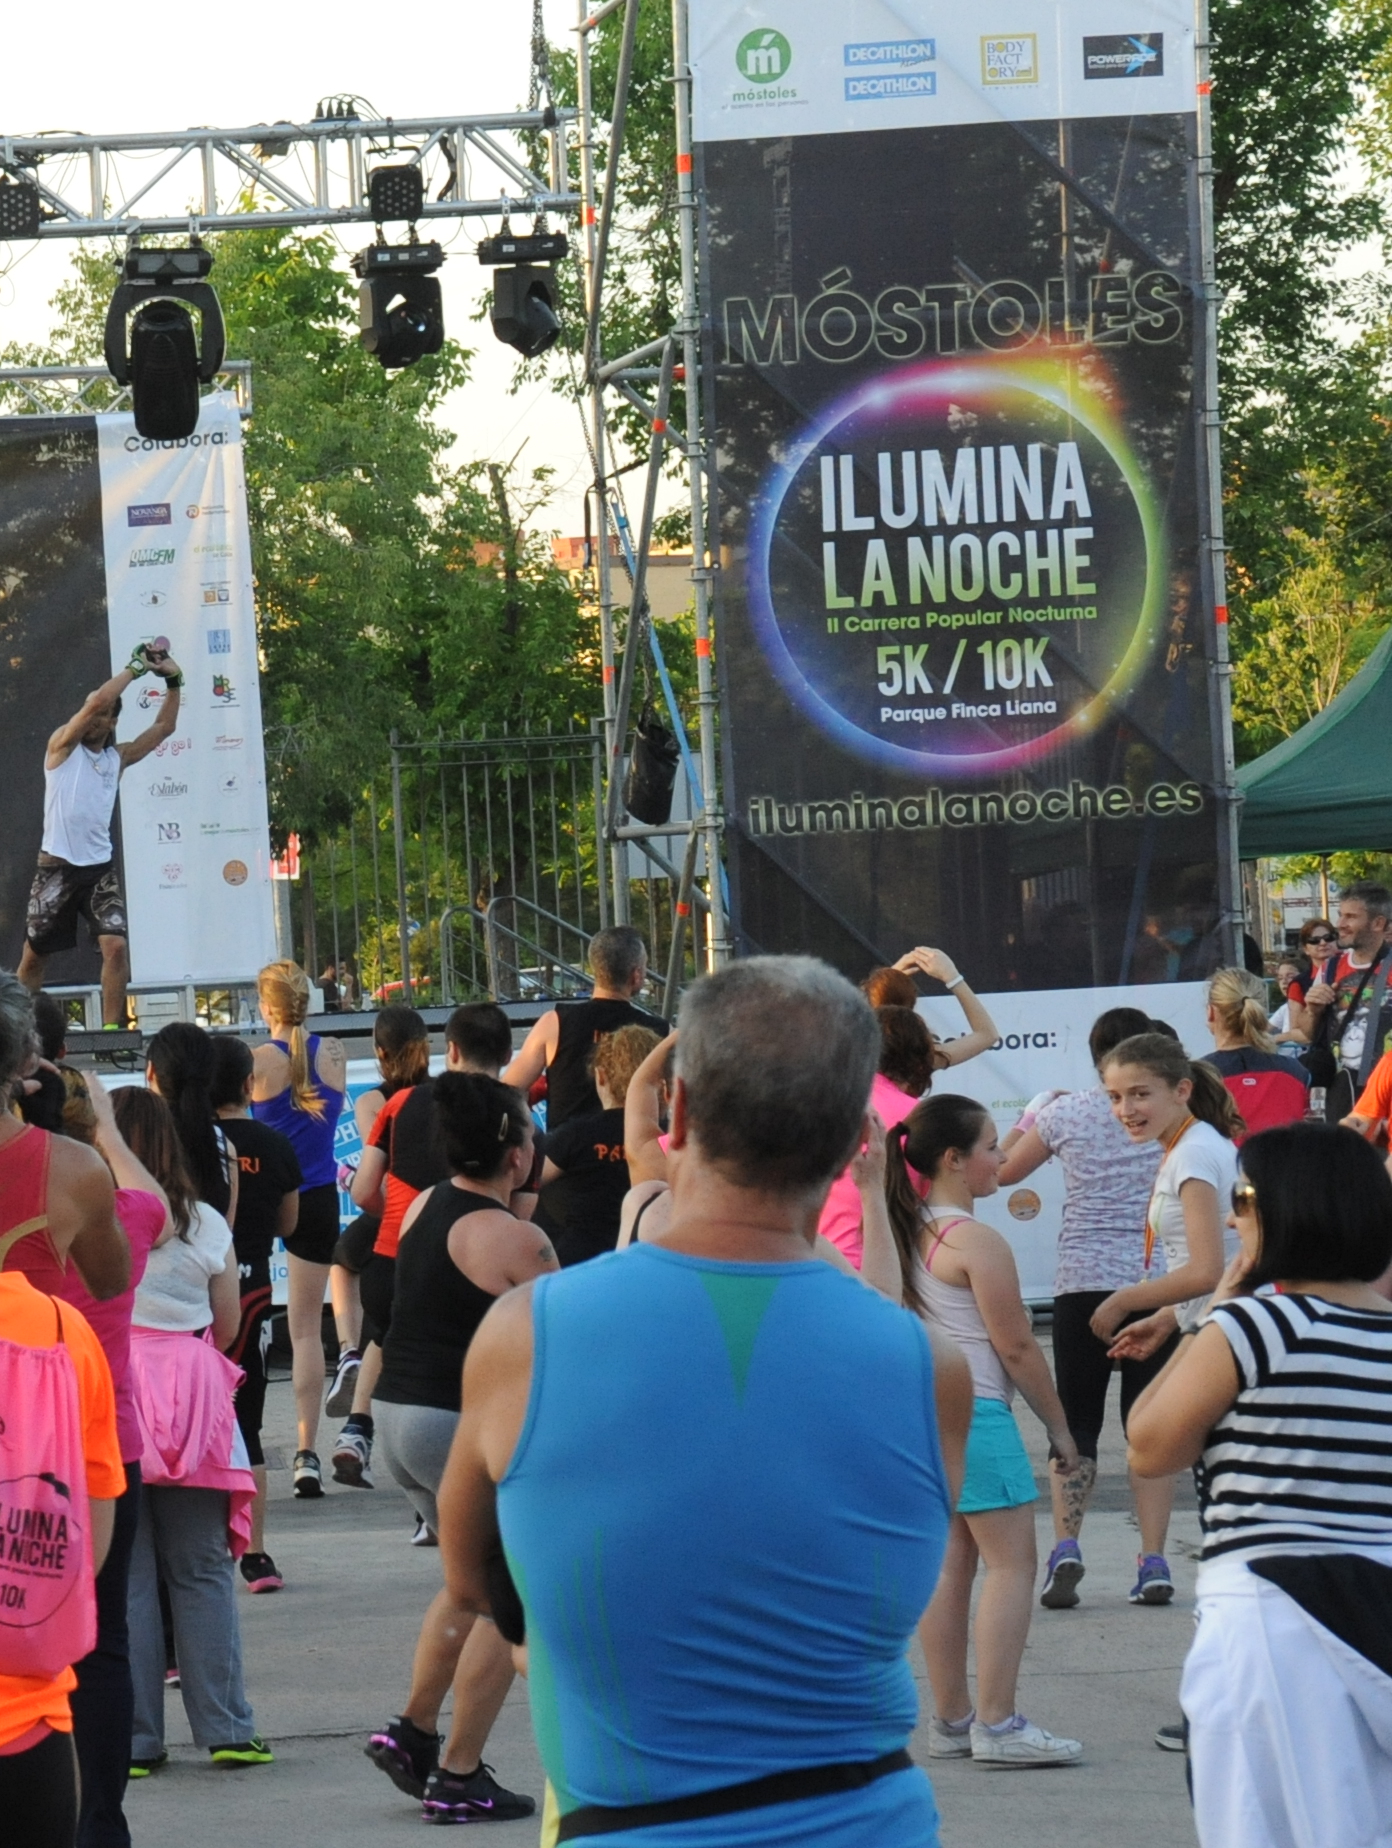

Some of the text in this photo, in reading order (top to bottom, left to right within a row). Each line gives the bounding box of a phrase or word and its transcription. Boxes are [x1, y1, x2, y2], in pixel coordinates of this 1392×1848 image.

[849, 43, 931, 61] DECATHLON
[987, 41, 1026, 54] BODY
[987, 53, 1023, 66] FACT
[733, 86, 797, 102] móstoles
[849, 76, 931, 95] DECATHLON
[723, 266, 1183, 367] MÓSTOLES
[820, 442, 1092, 532] ILUMINA
[823, 527, 1097, 609] LA NOCHE
[844, 614, 920, 631] Carrera
[926, 609, 1002, 630] Popular
[1008, 604, 1097, 623] Nocturna
[877, 644, 933, 696] 5K
[977, 636, 1053, 690] 10K
[881, 699, 1056, 723] Parque Finca Liana
[748, 779, 1205, 835] iluminalanoche.es
[7, 1538, 69, 1570] NCHE
